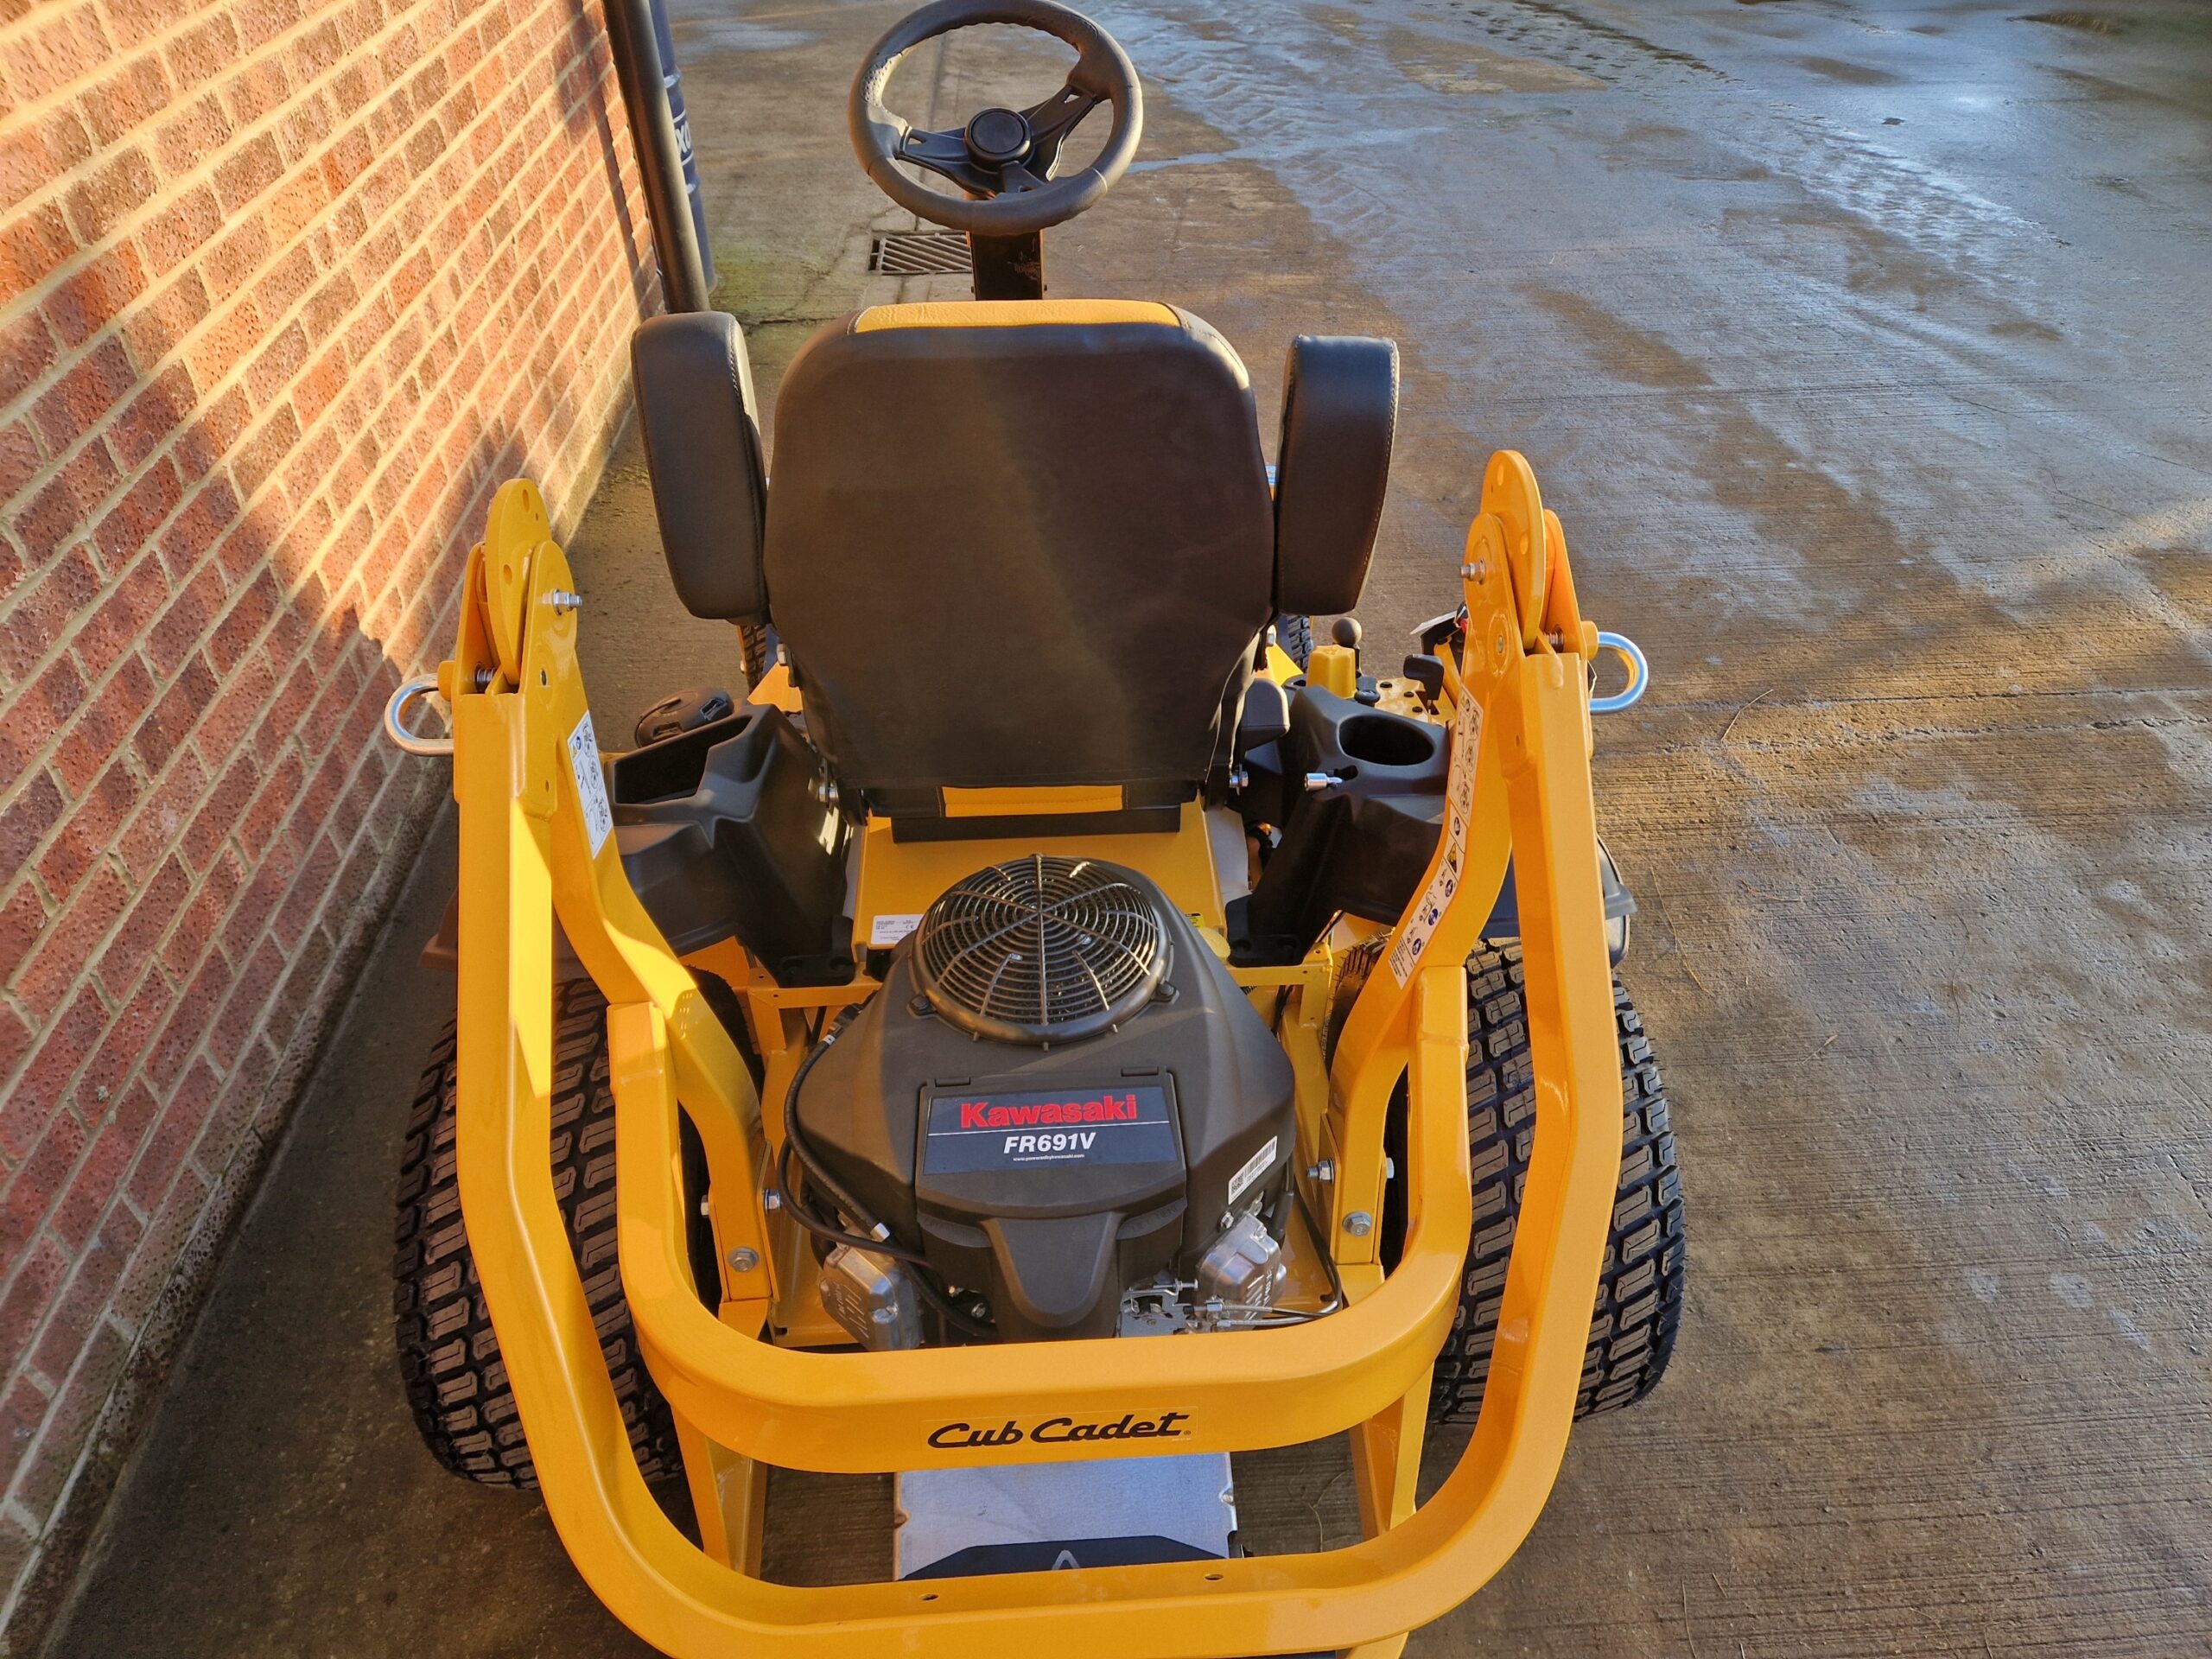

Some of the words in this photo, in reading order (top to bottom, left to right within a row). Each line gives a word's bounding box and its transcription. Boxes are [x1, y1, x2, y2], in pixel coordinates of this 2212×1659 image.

[960, 1094, 1138, 1129] Kawasaki
[1003, 1131, 1096, 1154] FR691V
[927, 1421, 1024, 1449] Cub
[1029, 1412, 1191, 1444] Cadet
